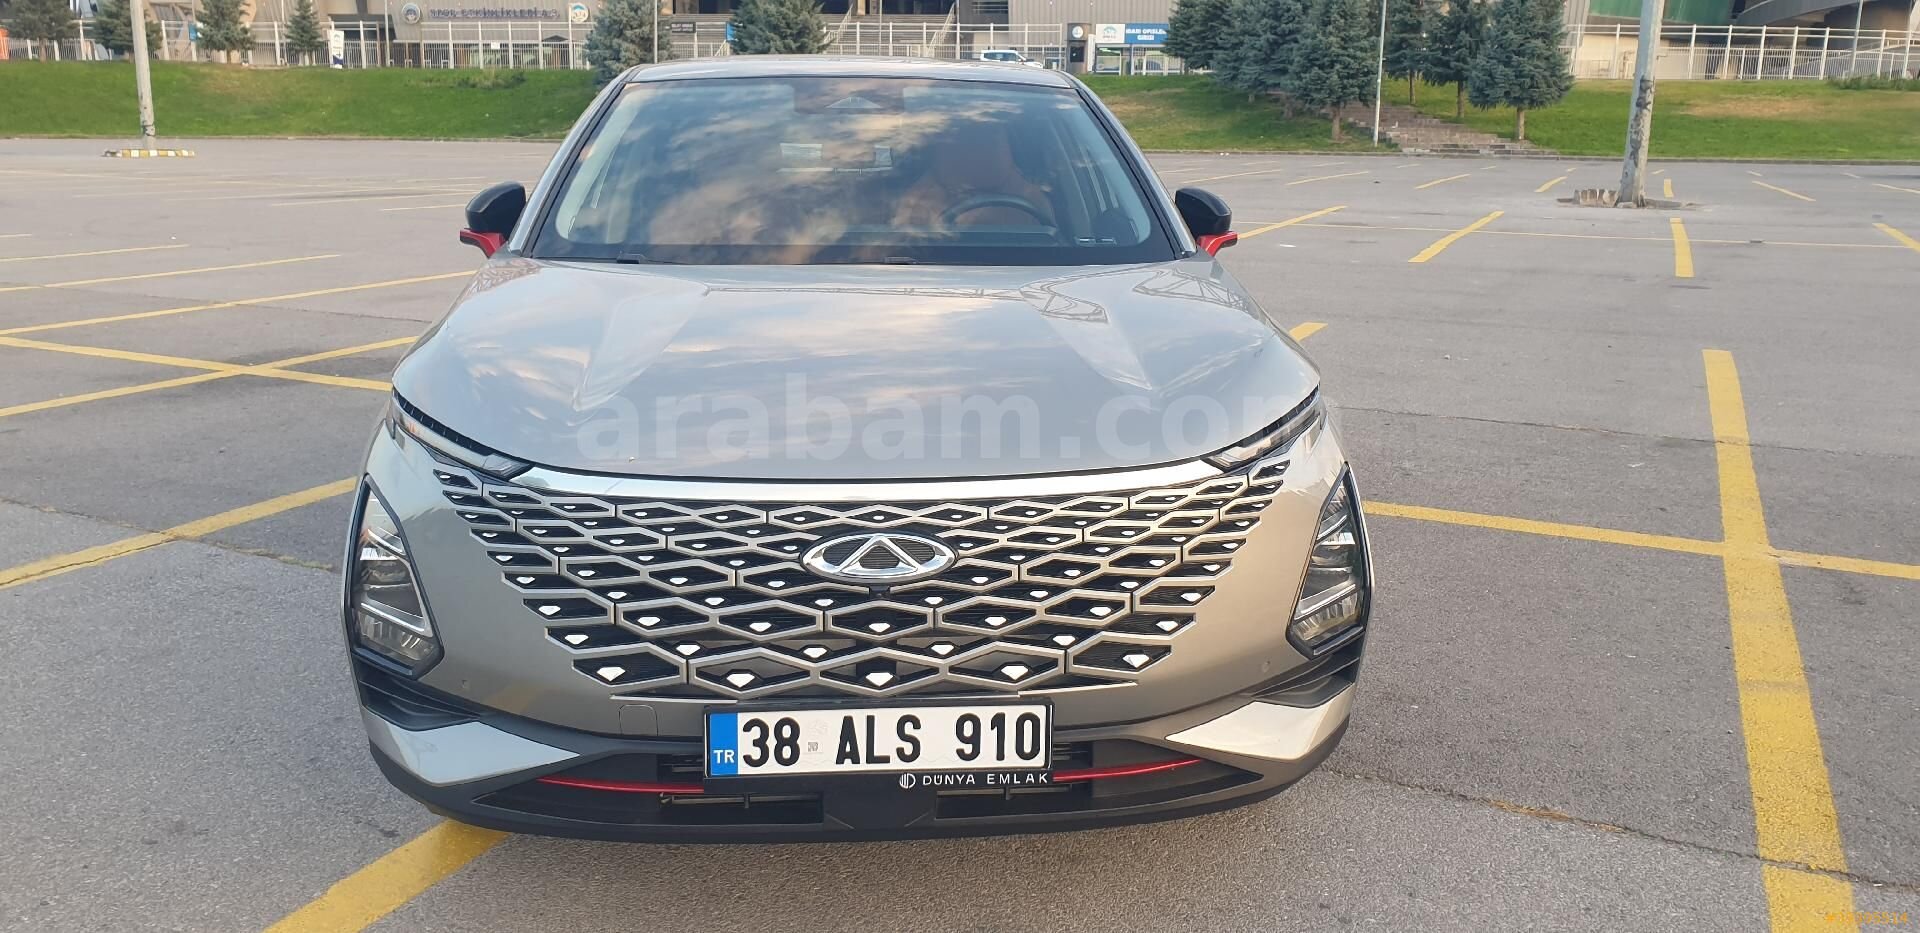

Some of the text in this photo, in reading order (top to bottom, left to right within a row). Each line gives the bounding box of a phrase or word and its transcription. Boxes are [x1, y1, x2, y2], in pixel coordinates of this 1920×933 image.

[713, 712, 1041, 767] TR 38 ALS 910
[922, 772, 1048, 786] DÜNYA EMLAK
